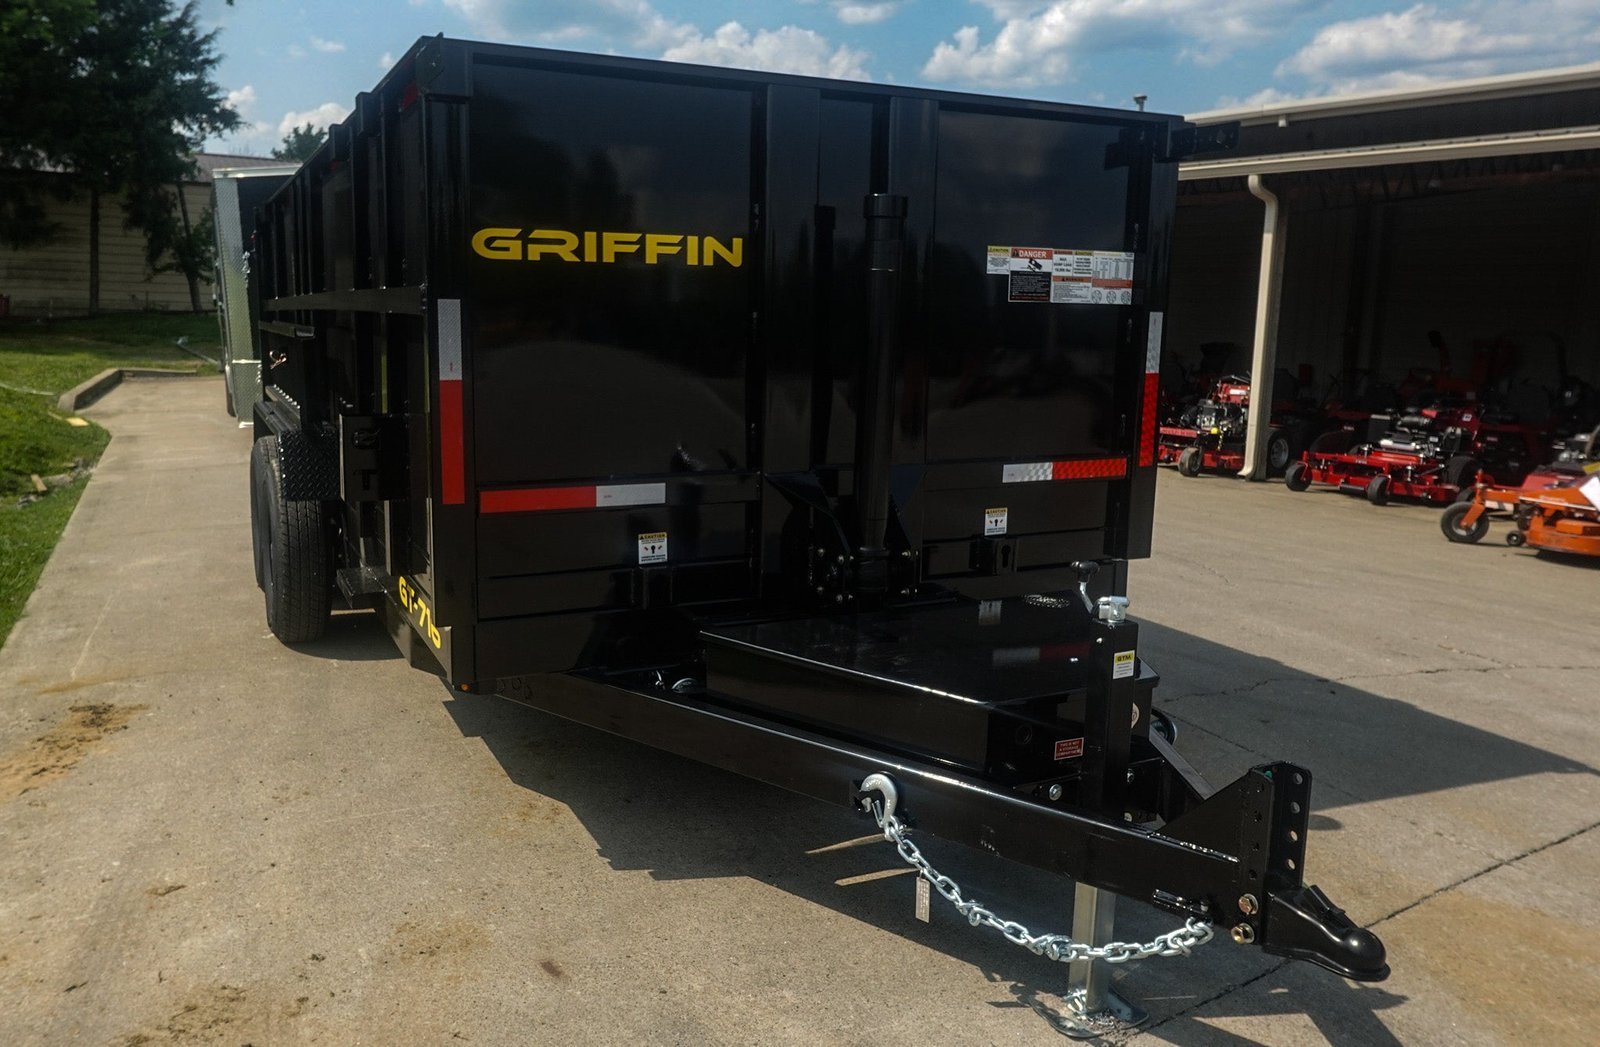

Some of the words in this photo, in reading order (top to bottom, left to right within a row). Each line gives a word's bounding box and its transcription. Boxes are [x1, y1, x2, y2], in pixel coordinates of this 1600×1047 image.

[472, 227, 743, 268] GRIFFIN
[1018, 249, 1047, 258] DANGER
[398, 576, 442, 649] GT-716
